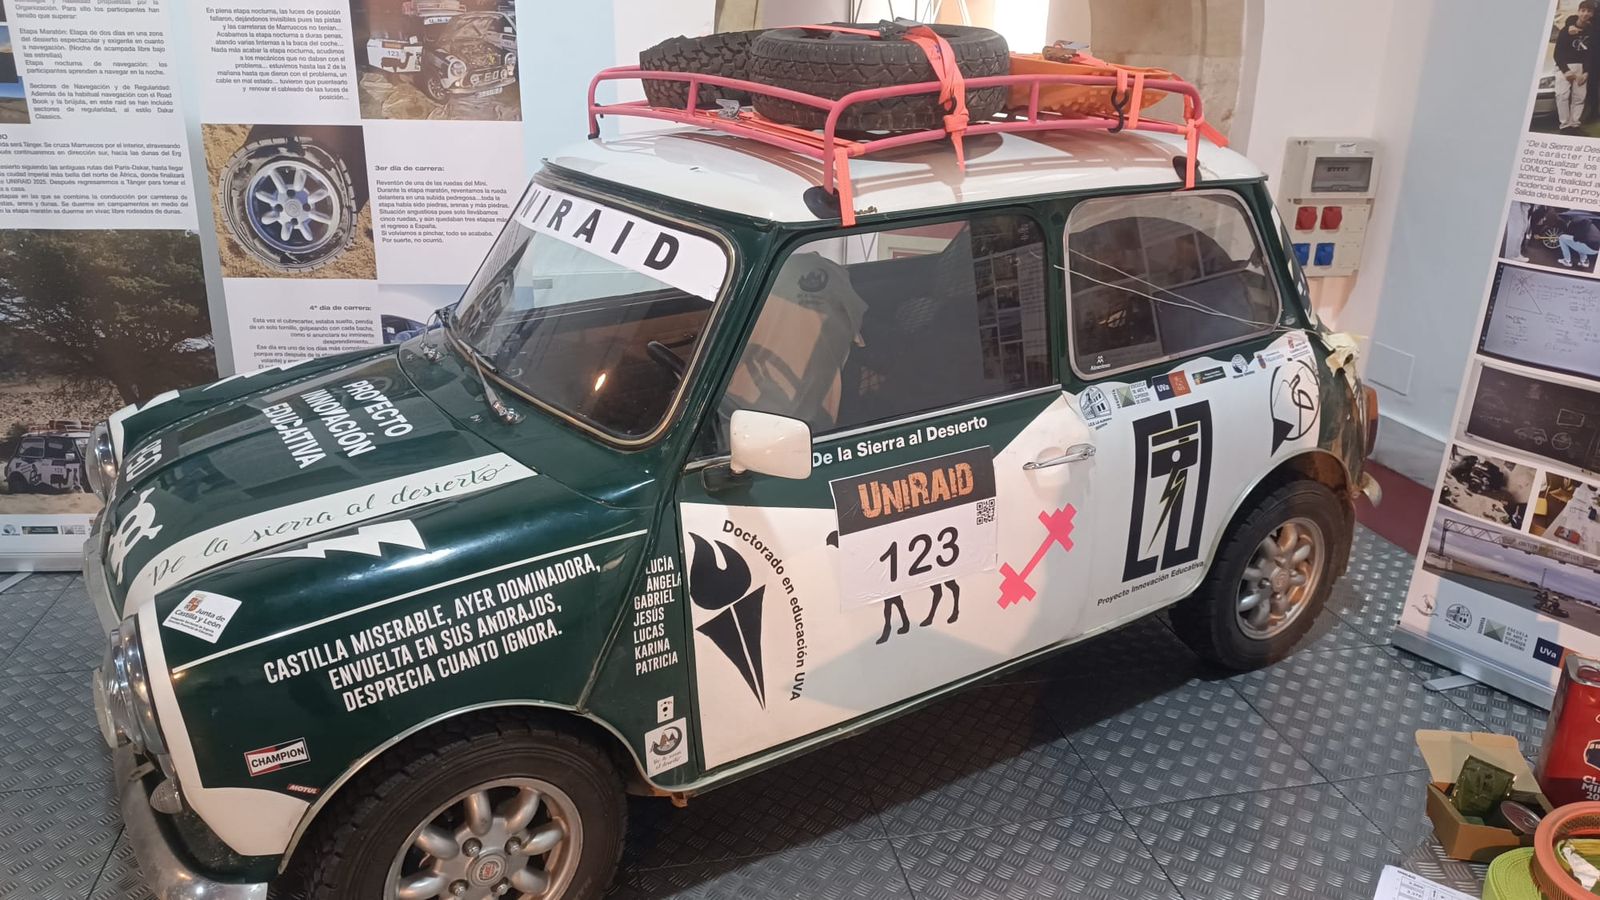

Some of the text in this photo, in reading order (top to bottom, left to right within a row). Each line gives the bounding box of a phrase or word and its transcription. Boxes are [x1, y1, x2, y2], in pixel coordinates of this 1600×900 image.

[1549, 142, 1573, 151] Sierra
[1522, 157, 1579, 168] contextualizar
[1560, 168, 1582, 178] Tiene
[1558, 178, 1592, 187] realidad
[1514, 188, 1536, 197] Salida
[1560, 195, 1598, 204] alumnos
[520, 189, 680, 270] NIRAID
[1157, 384, 1170, 392] UVa
[342, 380, 413, 437] PROYECTO
[301, 388, 376, 458] INNOVACIÓN
[262, 402, 326, 470] EDUCATIVA
[812, 416, 988, 468] De la Sierra al Desierto
[858, 462, 974, 519] UNIRAID
[203, 535, 230, 557] la
[241, 510, 334, 545] sierra
[343, 494, 375, 518] al
[392, 464, 511, 505] desierto
[645, 555, 674, 575] LUCÍA
[879, 526, 960, 582] 123
[1097, 562, 1204, 606] Proyecto Innovación Educativa
[634, 589, 675, 610] GABRIEL
[174, 610, 198, 620] Castilla
[203, 618, 222, 629] León
[196, 608, 215, 618] Junta
[264, 552, 601, 684] CASTILLA MISERABLE, AYER DOMINADORA,
[634, 605, 665, 628] JESÚS
[722, 520, 808, 702] Doctorado en educación UVA
[329, 593, 562, 691] ENVUELTA EN SUS ANDRAJOS,
[633, 624, 665, 644] LUCAS
[634, 640, 671, 661] KARINA
[1540, 646, 1557, 658] UVa
[343, 618, 563, 712] DESPRECIA CUANTO IGNORA.
[635, 652, 678, 676] PATRICIA
[250, 746, 305, 768] CHAMPION
[288, 784, 318, 795] MOTUL
[1582, 775, 1600, 785] CL
